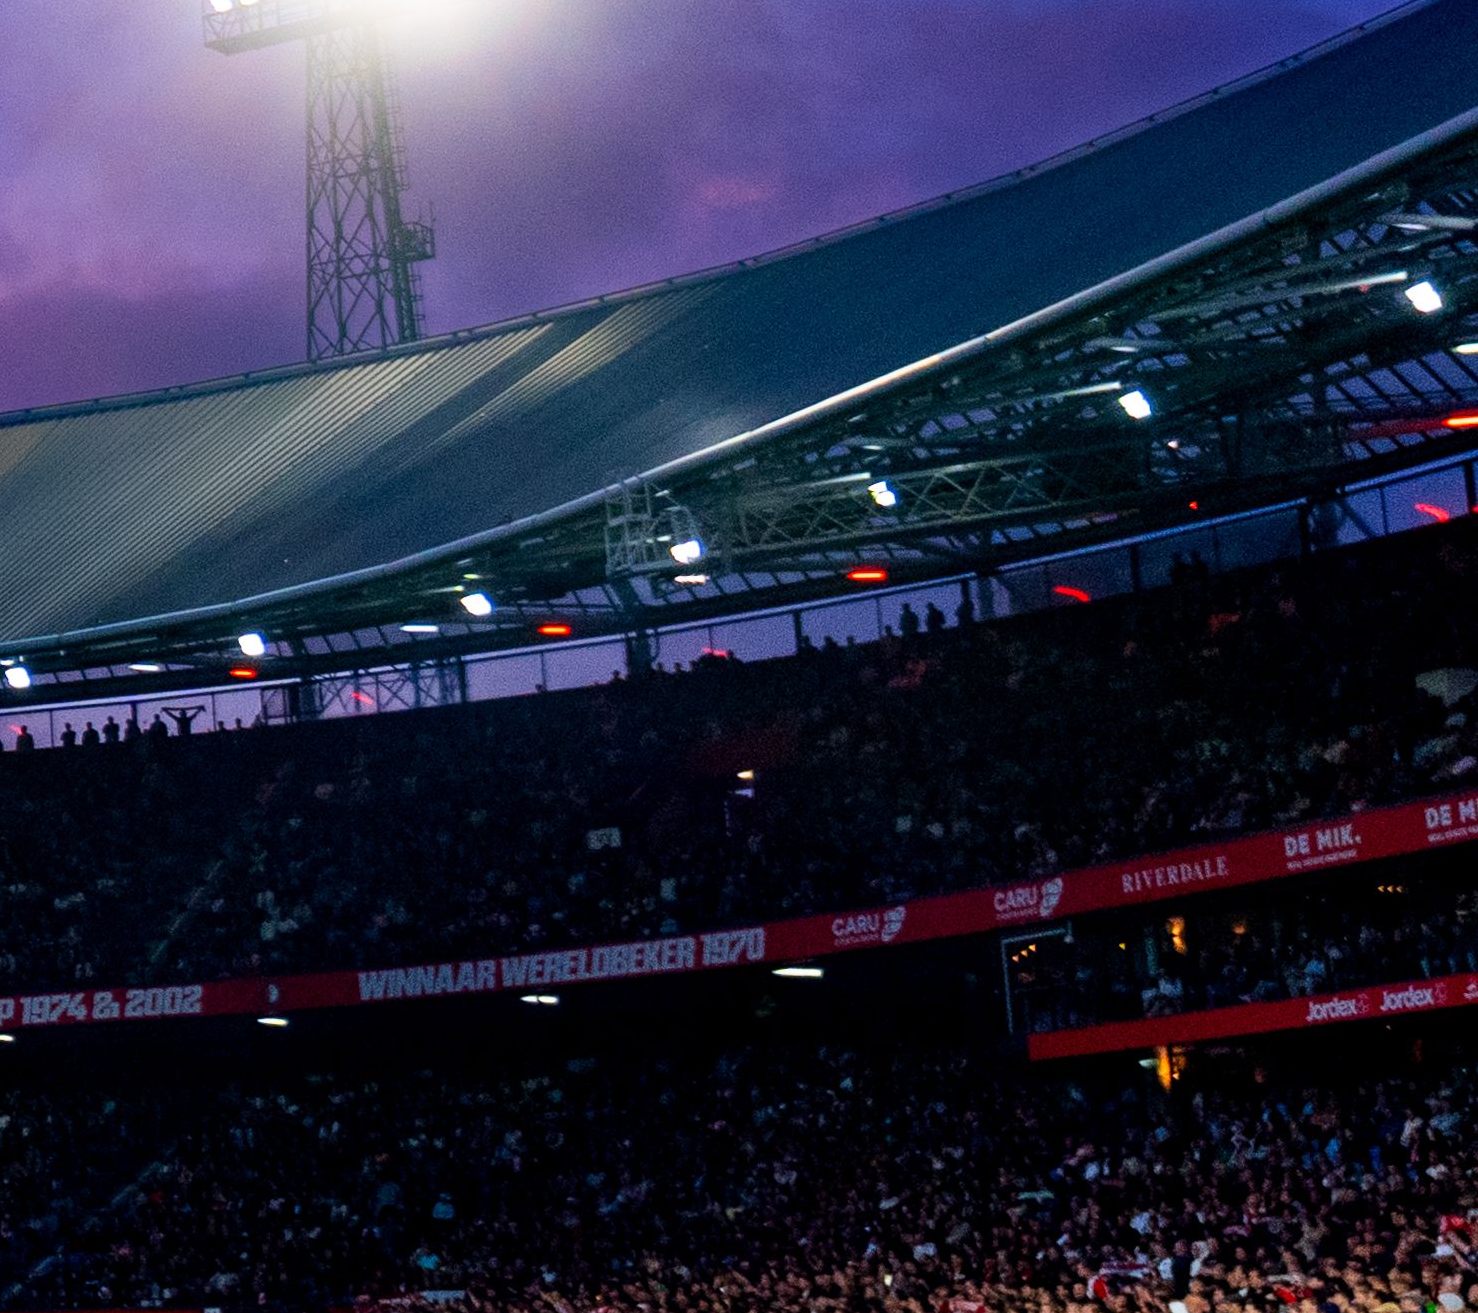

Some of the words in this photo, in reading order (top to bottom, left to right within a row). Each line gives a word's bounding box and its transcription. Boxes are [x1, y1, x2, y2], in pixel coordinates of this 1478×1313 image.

[1424, 804, 1452, 829] DE
[1284, 834, 1310, 857] DE
[1121, 856, 1229, 894] RIVERDALE
[994, 884, 1038, 912] CARU
[832, 914, 879, 937] CARU
[359, 959, 496, 1001] WINNAAR
[498, 935, 696, 988] WERELDBEKER
[700, 926, 766, 965] 1970
[21, 991, 87, 1025] 1974
[91, 989, 120, 1020] &
[124, 984, 203, 1017] 2002
[1306, 997, 1358, 1022] Jordex
[1380, 986, 1435, 1011] Jordex
